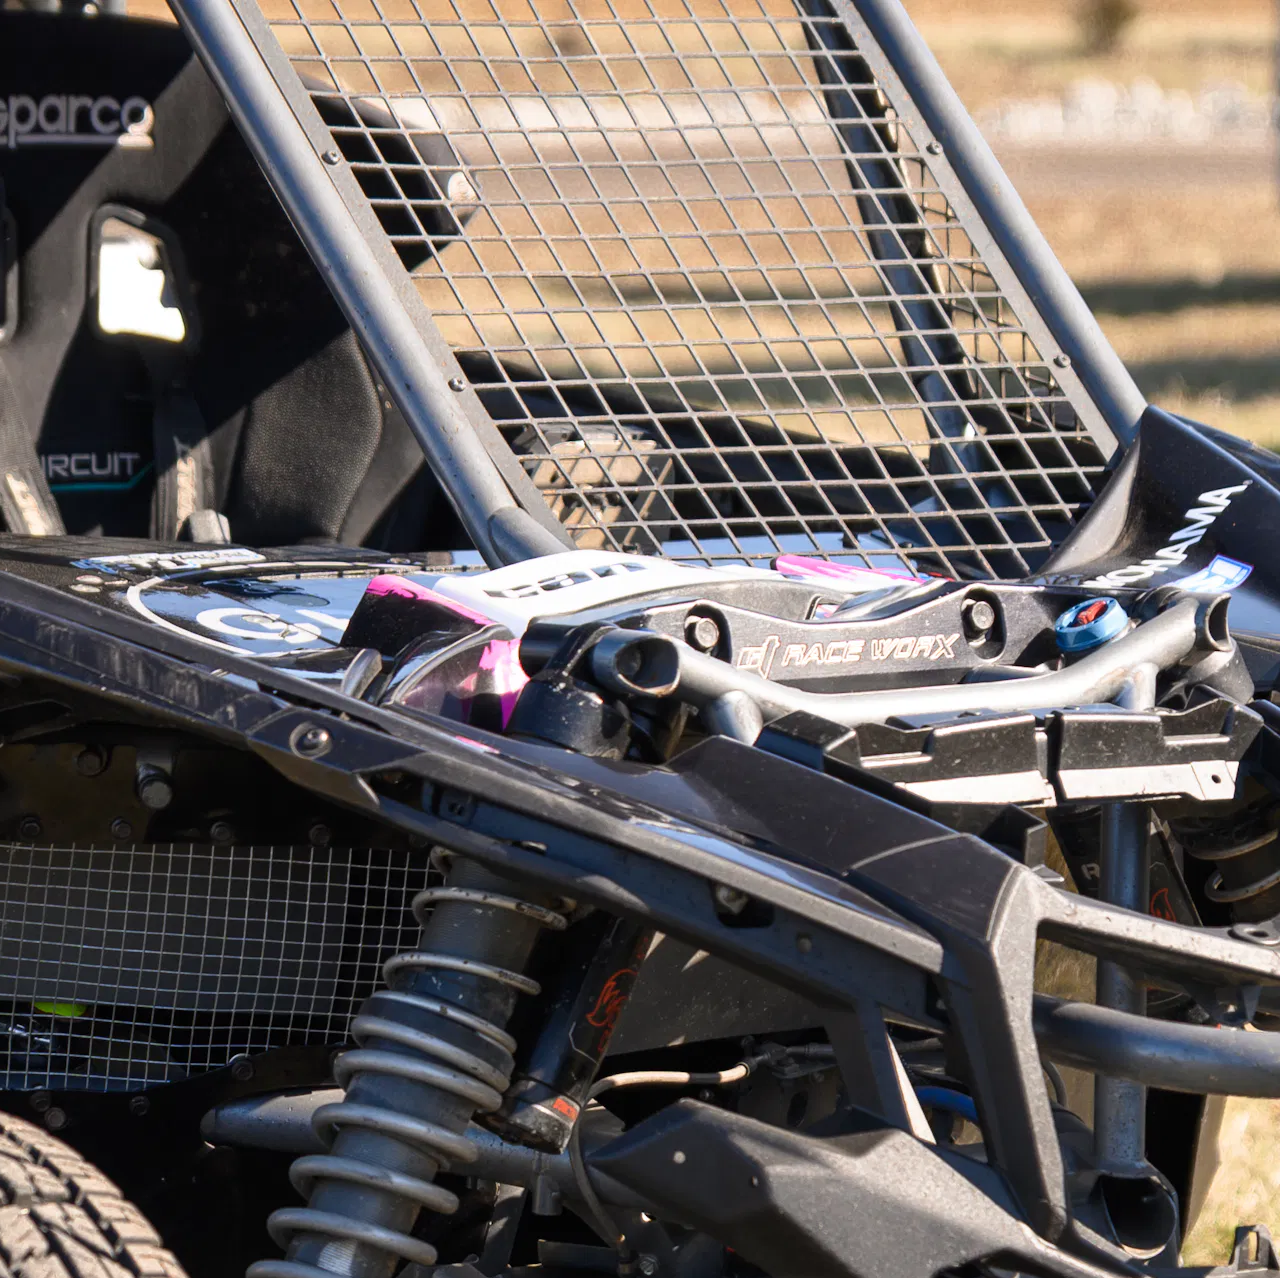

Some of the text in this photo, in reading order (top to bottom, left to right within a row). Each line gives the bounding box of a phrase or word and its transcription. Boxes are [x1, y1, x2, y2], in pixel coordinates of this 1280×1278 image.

[40, 452, 140, 478] IRCUIT
[1082, 485, 1248, 588] KOHAMA
[781, 639, 866, 668] RACE
[870, 633, 961, 660] WORX
